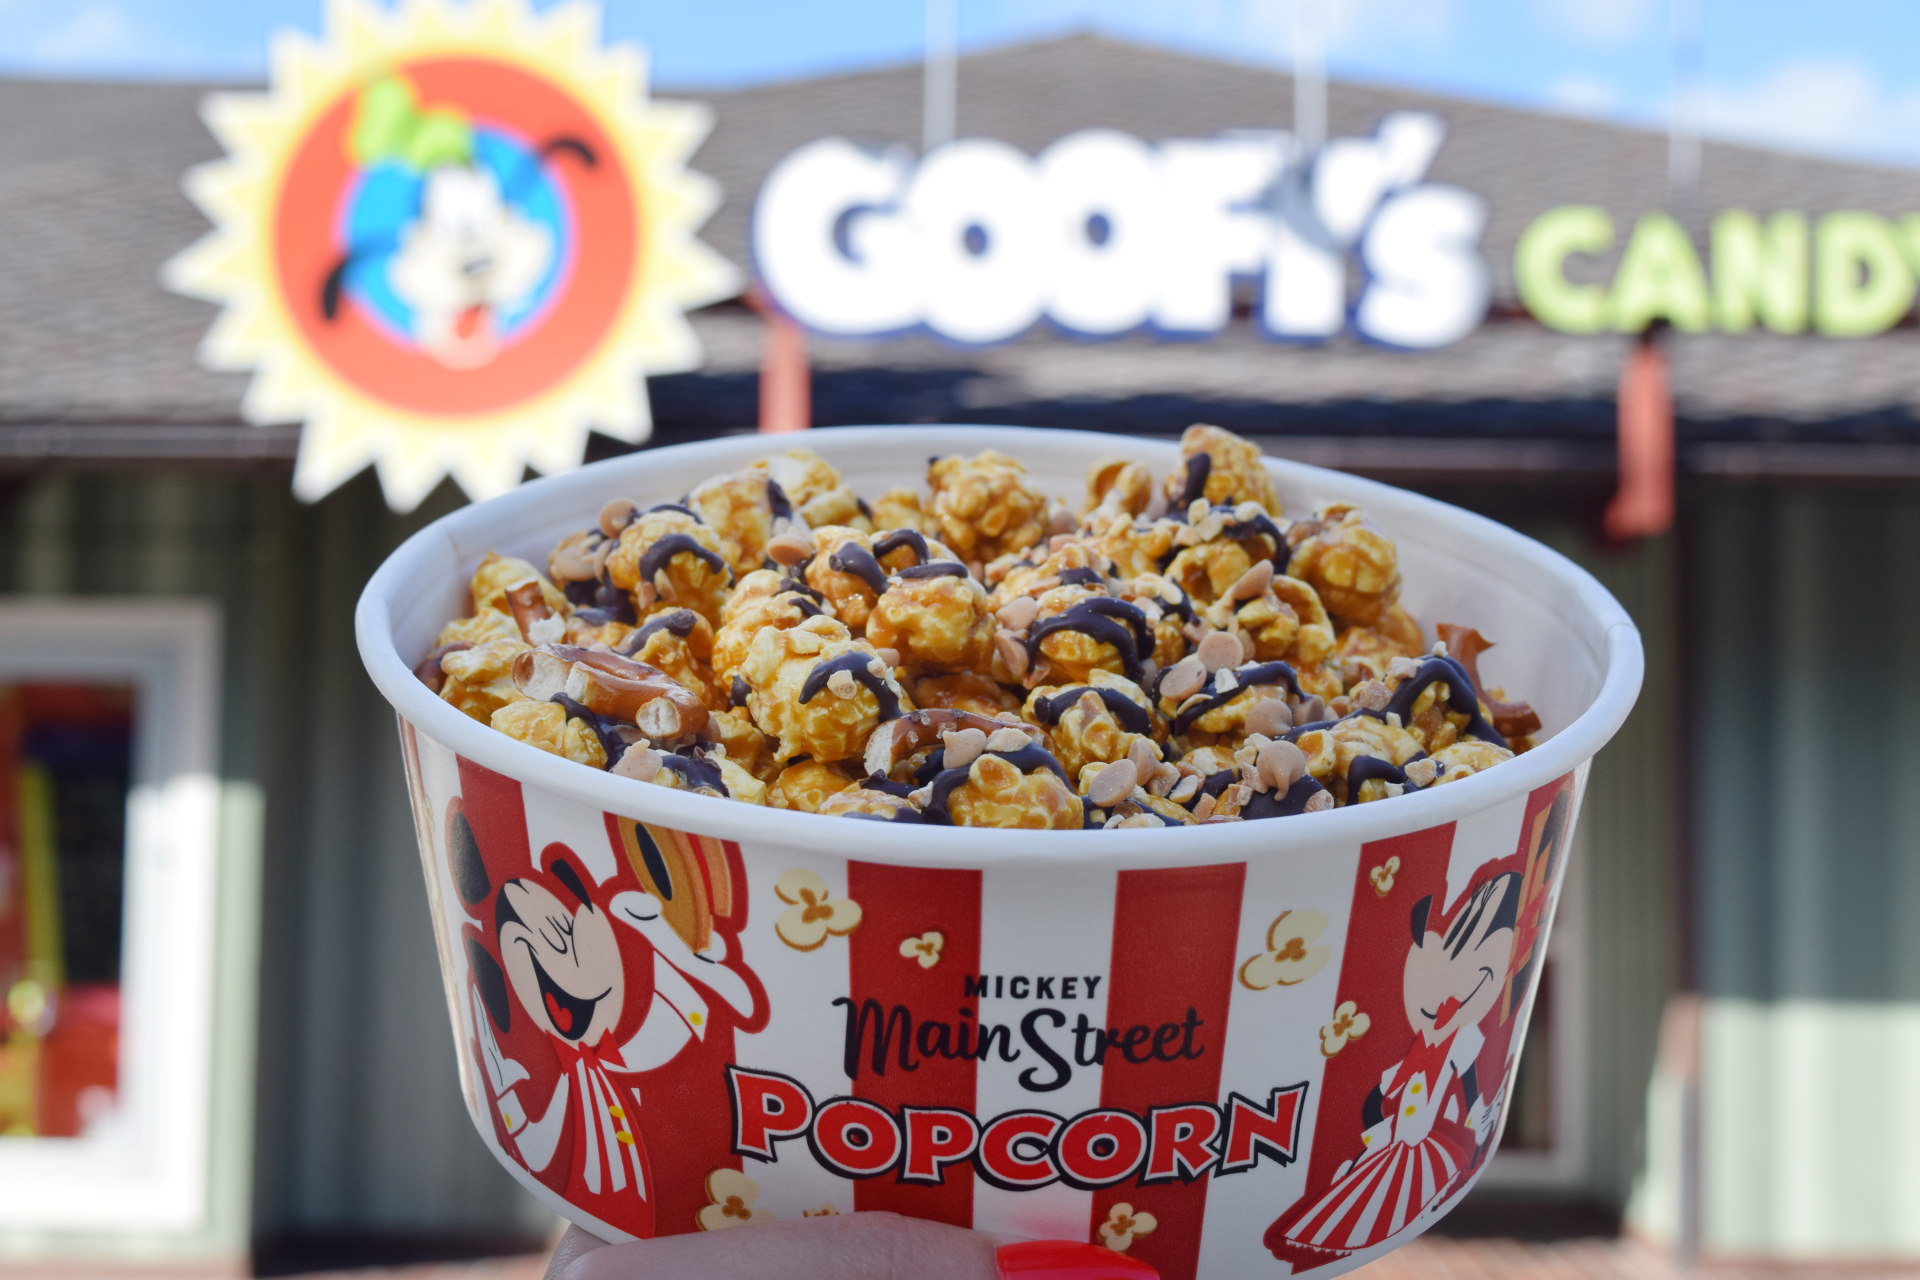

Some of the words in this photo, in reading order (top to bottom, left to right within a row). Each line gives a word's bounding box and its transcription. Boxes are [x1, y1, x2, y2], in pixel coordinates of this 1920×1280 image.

[1514, 204, 1920, 337] CAND
[963, 975, 1102, 999] MICKEY
[832, 997, 1020, 1080] Main
[1018, 1008, 1205, 1092] Street
[724, 1064, 1309, 1191] POPCORN
